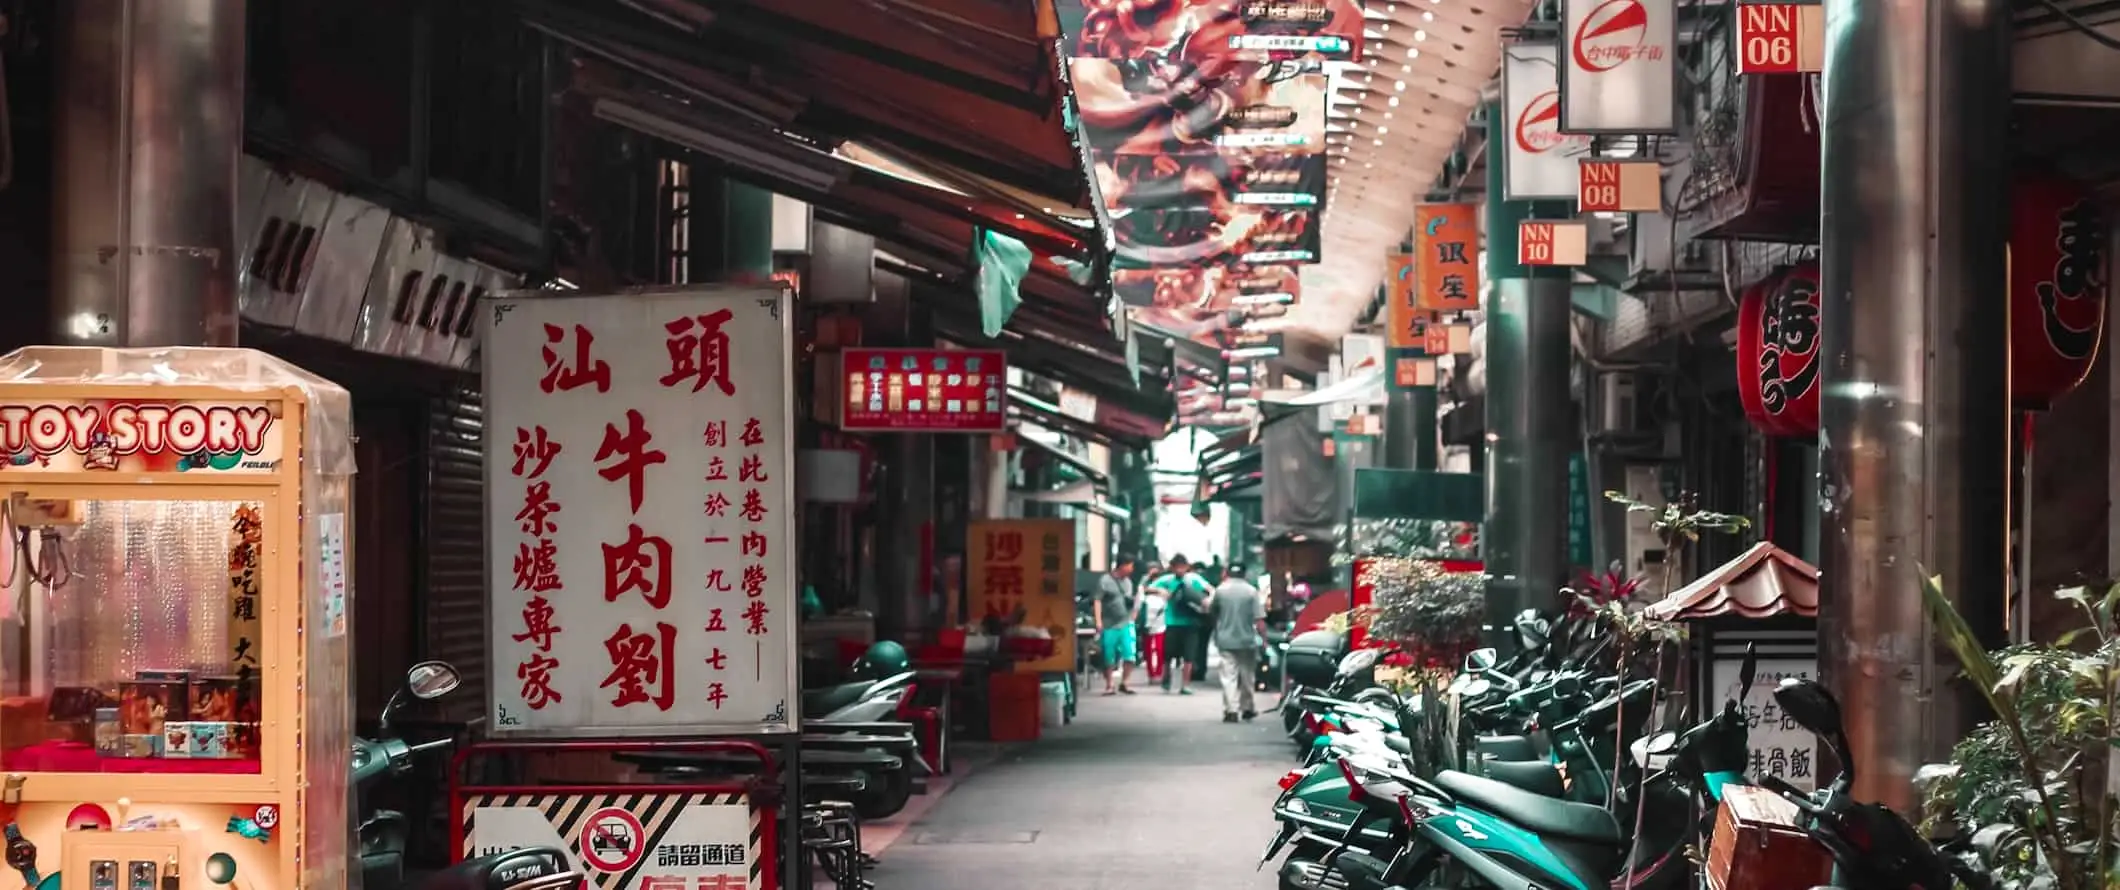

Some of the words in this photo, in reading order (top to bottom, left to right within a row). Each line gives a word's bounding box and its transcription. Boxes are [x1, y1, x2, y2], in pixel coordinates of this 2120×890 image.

[1747, 5, 1789, 32] NN
[1748, 37, 1791, 65] 06
[1585, 164, 1620, 183] NN
[1585, 186, 1617, 206] 08
[1524, 224, 1551, 241] NN
[1527, 243, 1549, 261] 10
[540, 308, 735, 397] 汕頭
[0, 405, 102, 456] TOY
[107, 405, 274, 455] STORY
[594, 409, 678, 712] 牛肉劉
[703, 420, 732, 709] 創立於一九五七年
[657, 844, 745, 866] 請留通道
